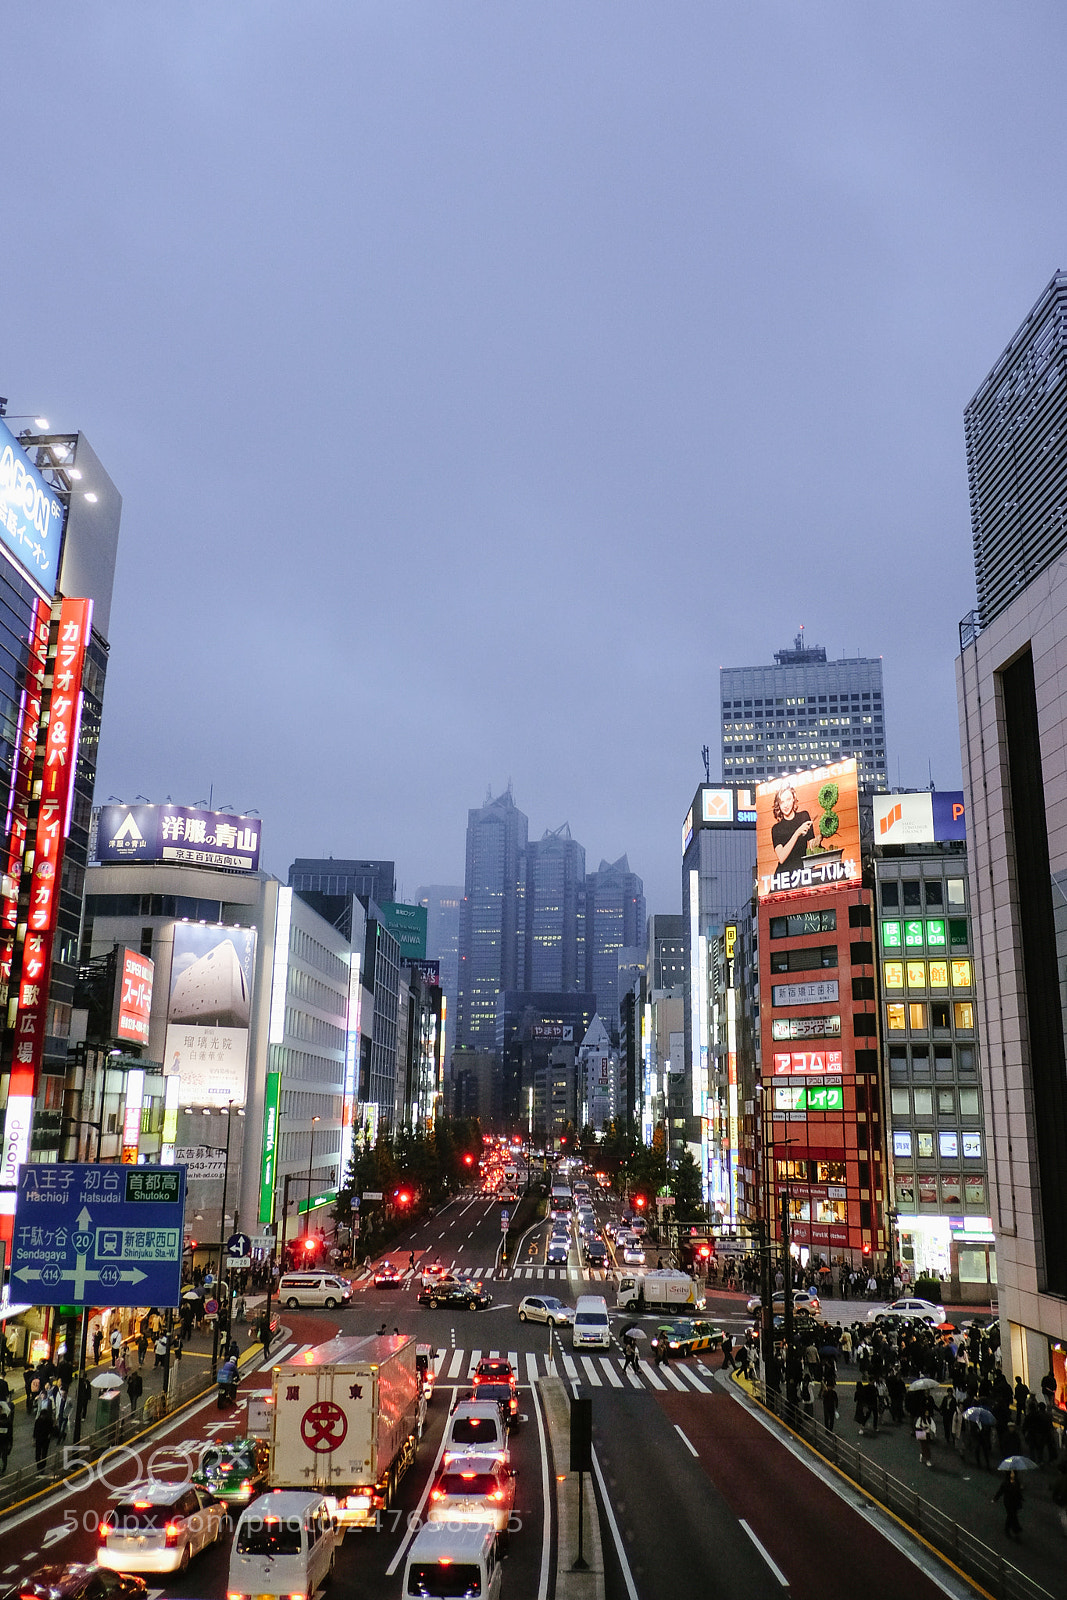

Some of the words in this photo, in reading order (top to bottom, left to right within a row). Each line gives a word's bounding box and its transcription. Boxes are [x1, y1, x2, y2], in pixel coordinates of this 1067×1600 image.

[42, 621, 79, 857] カラオケ&パーティー
[952, 803, 965, 821] P
[162, 815, 258, 852] 洋服の青山
[108, 840, 147, 848] 洋服の青山
[175, 849, 242, 866] 京王百貨店向い
[761, 858, 857, 891] THEグローバル社
[886, 922, 941, 935] ほぐし
[400, 934, 421, 945] MIWA
[17, 886, 50, 1064] カラオケ歌広場
[126, 959, 142, 977] SUPER
[887, 967, 946, 984] 占い館
[779, 984, 834, 998] 新宿矯正歯科
[534, 1026, 562, 1035] やまや
[791, 1024, 840, 1035] エーアイアール
[183, 1036, 233, 1050] 瑠璃光院
[777, 1053, 824, 1072] アコム
[828, 1053, 840, 1063] 6F
[807, 1090, 839, 1106] レイク
[176, 1149, 224, 1158] 広告募集中
[965, 1143, 979, 1151] タイ
[22, 1169, 75, 1189] 八王子
[83, 1169, 120, 1190] 初台
[129, 1174, 177, 1191] 首都高
[26, 1191, 69, 1205] Hachioji
[80, 1191, 121, 1203] Hatsudai
[134, 1191, 170, 1200] Shutoko
[18, 1226, 68, 1246] 千駄ヶ谷
[76, 1235, 89, 1248] 20
[124, 1231, 177, 1248] 新宿駅西口
[16, 1249, 67, 1262] Sendagaya
[124, 1249, 153, 1259] Shinjuku
[42, 1269, 59, 1279] 414
[102, 1270, 118, 1280] 414
